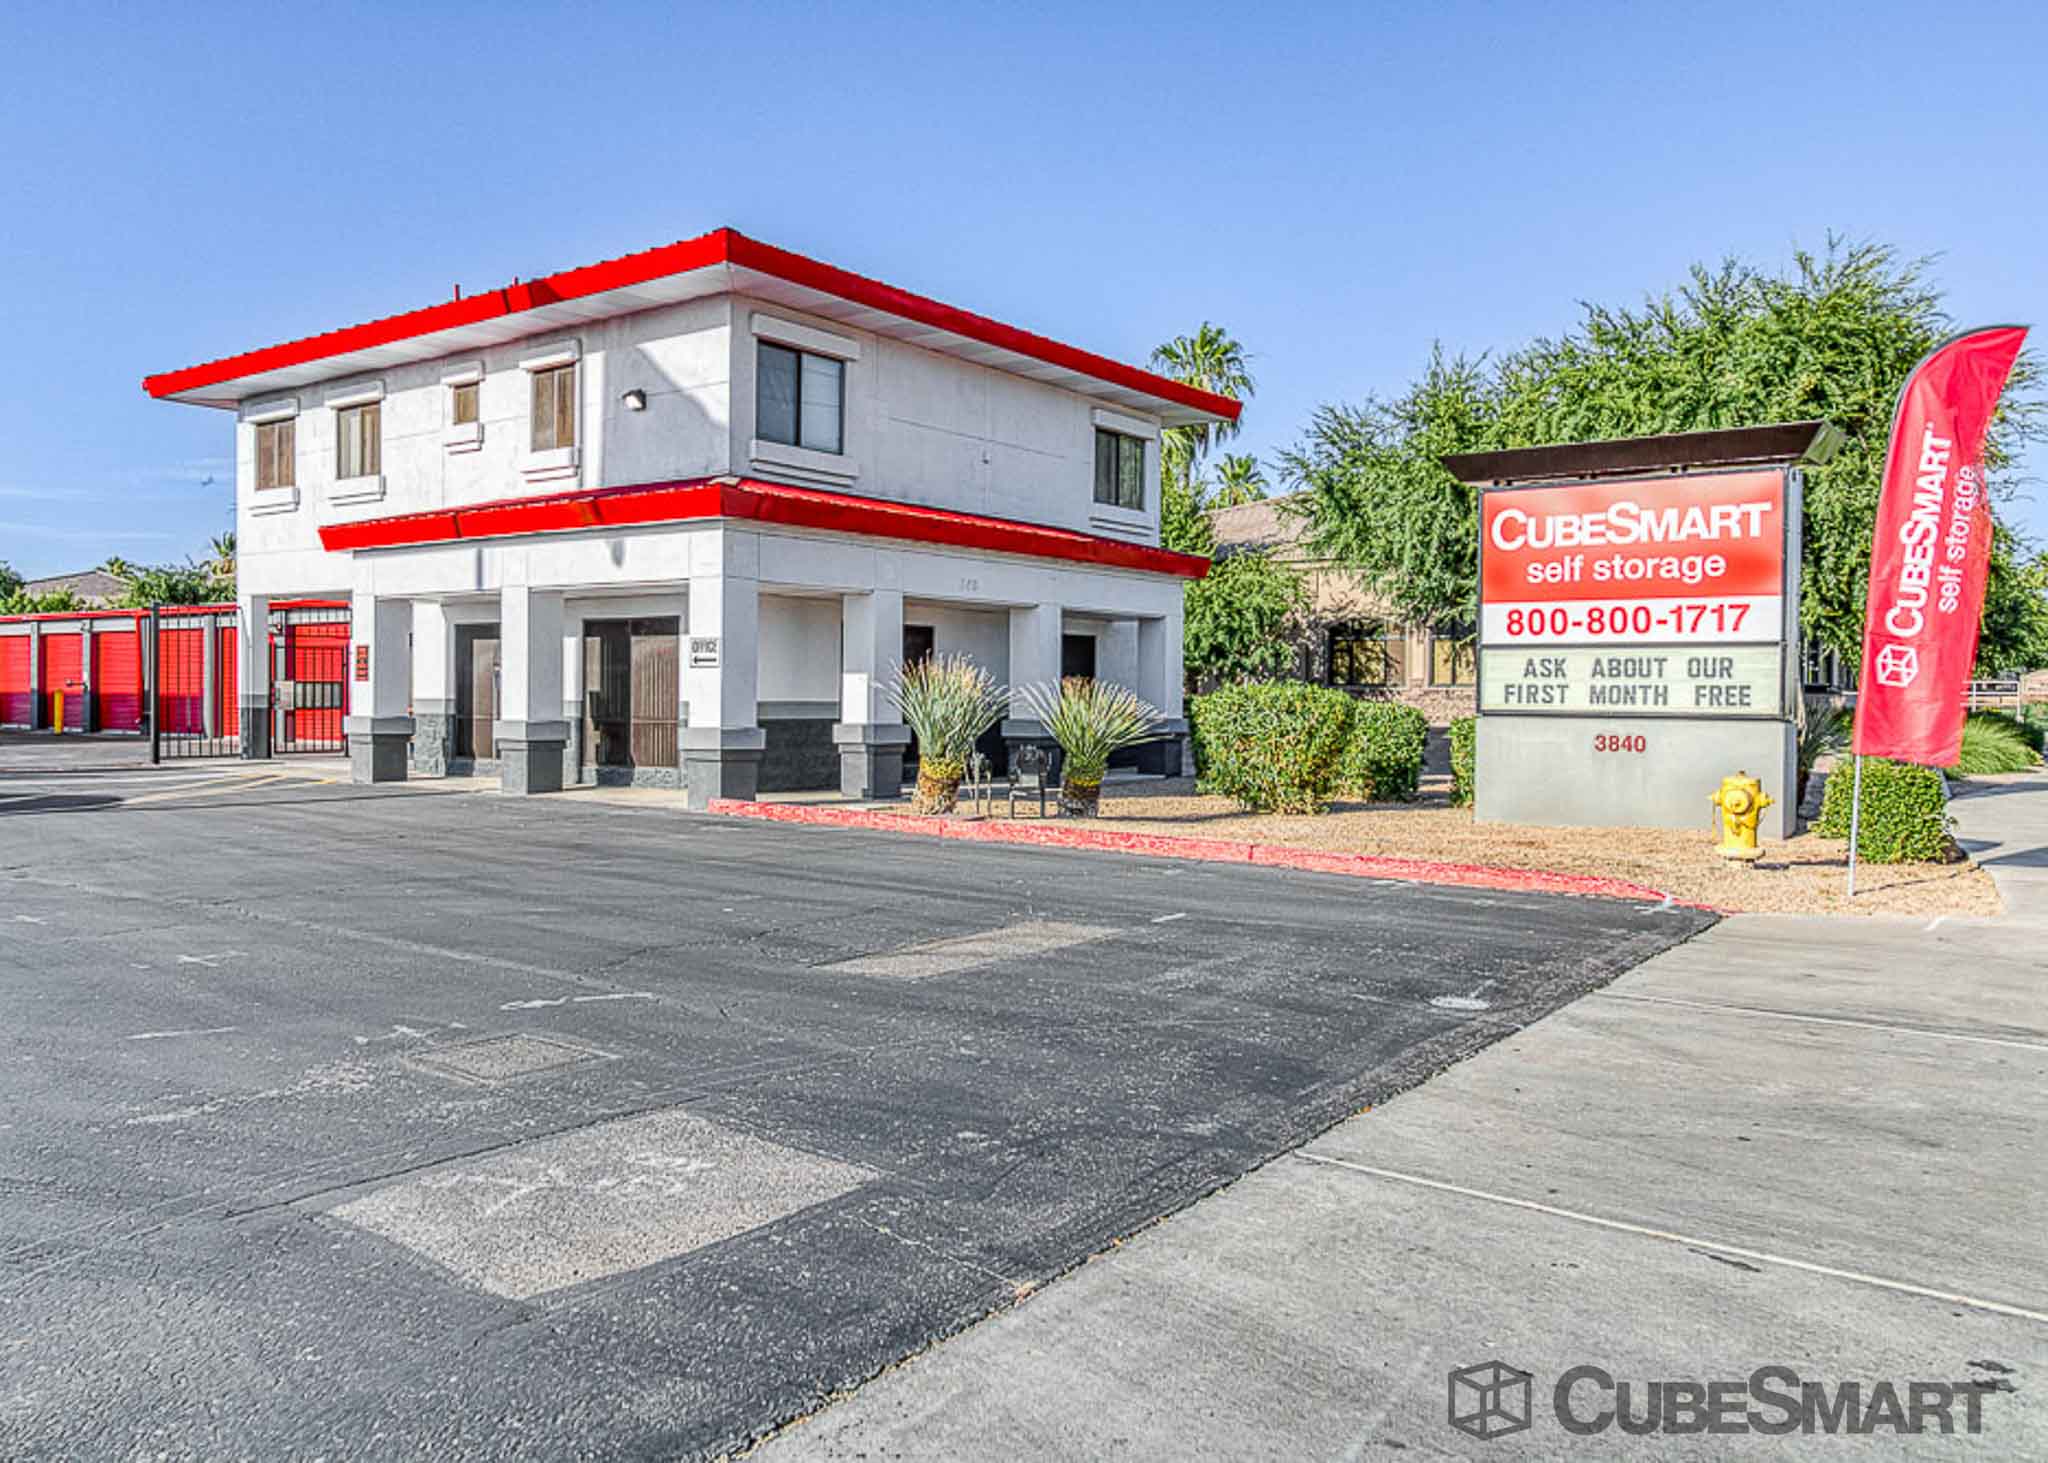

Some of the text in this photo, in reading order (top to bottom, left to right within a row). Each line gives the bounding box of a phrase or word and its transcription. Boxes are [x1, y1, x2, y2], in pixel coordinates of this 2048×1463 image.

[1491, 501, 1772, 551] CUBESMART
[1938, 465, 1979, 614] self storage
[1526, 552, 1727, 583] self storage
[1506, 604, 1751, 636] 800-800-1717
[1523, 657, 1733, 678] ASK ABOUT OUR
[1504, 685, 1751, 706] FIRST MONTH FREE
[1594, 735, 1646, 753] 3840
